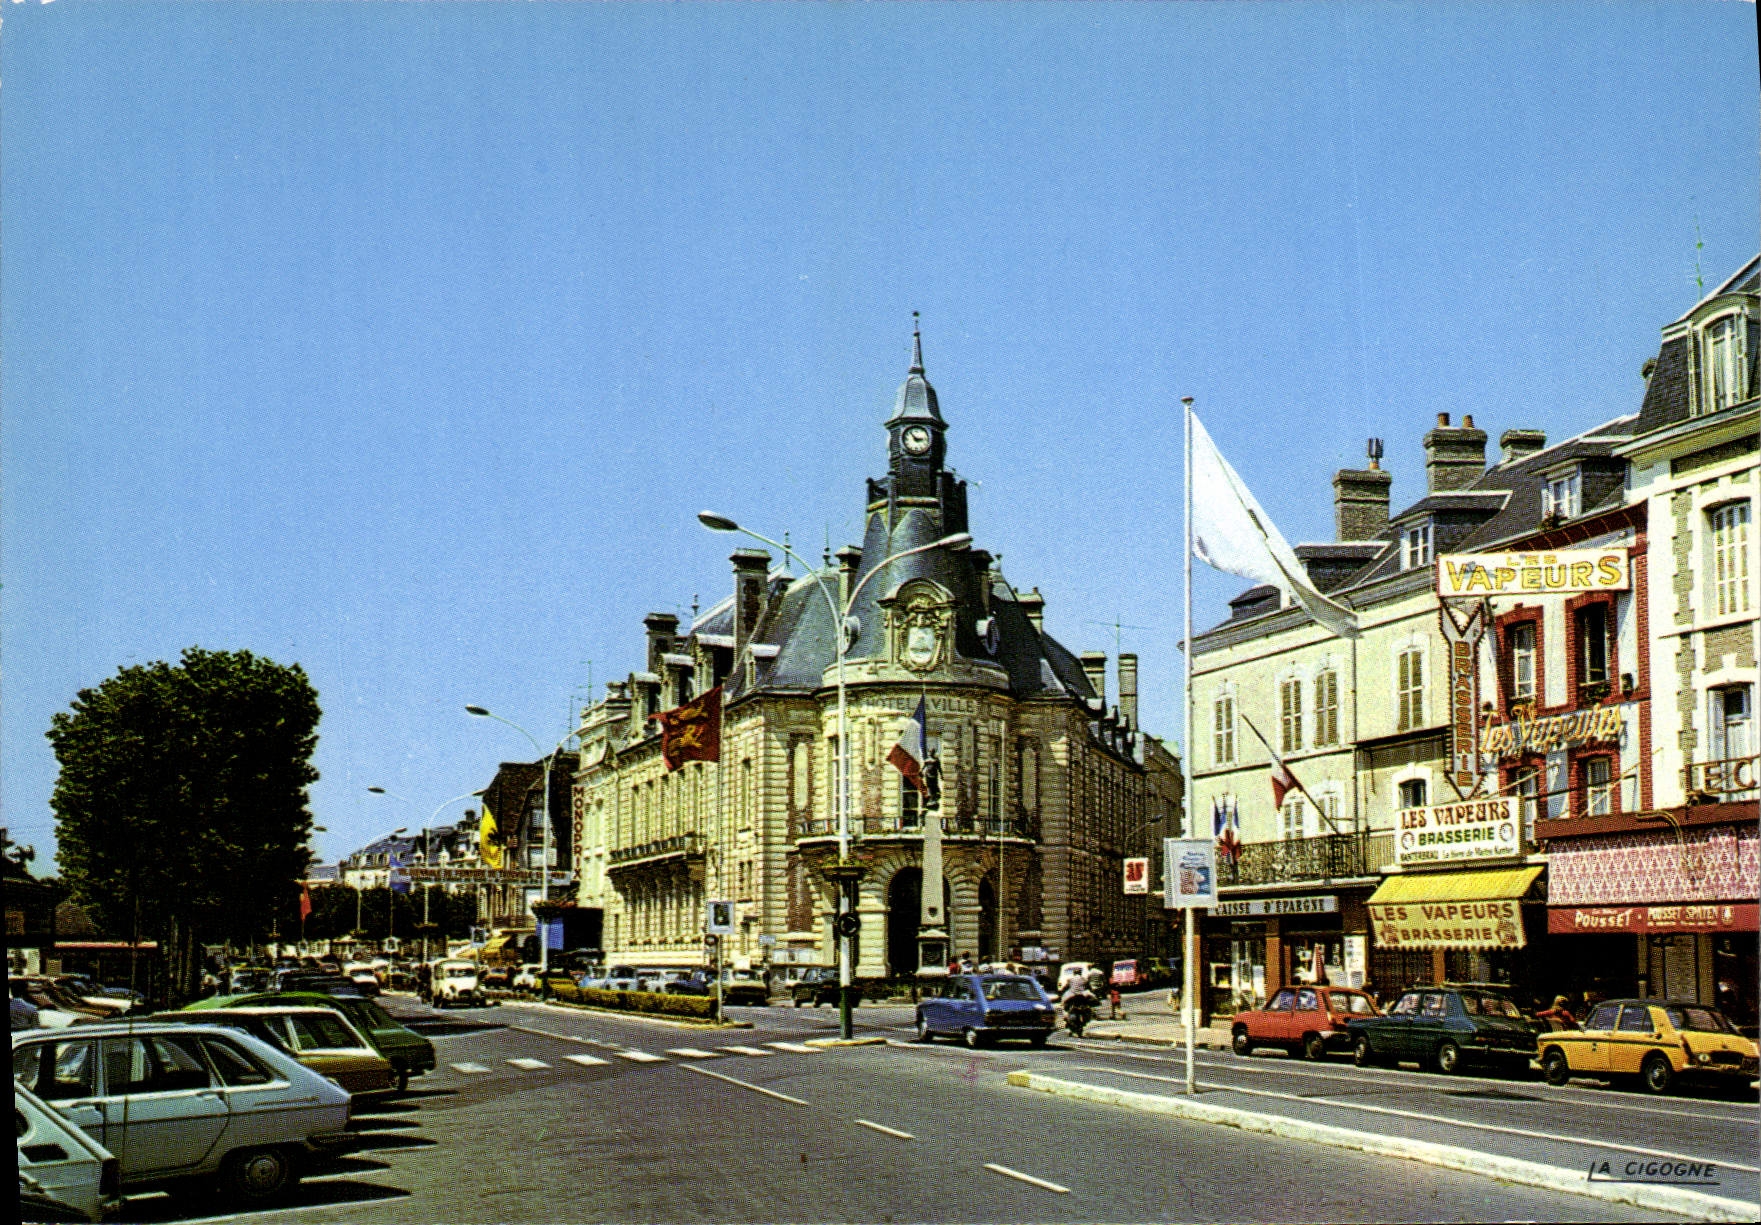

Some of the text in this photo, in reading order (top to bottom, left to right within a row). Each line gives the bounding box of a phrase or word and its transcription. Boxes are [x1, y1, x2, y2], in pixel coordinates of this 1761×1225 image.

[1506, 555, 1557, 566] LES
[1446, 555, 1622, 591] VAPEURS
[931, 697, 975, 713] VILLE
[1454, 641, 1473, 787] BRASSERIE
[1480, 700, 1622, 754] Les Vapeurs
[1401, 800, 1510, 829] LES VAPEURS
[573, 786, 584, 880] MONOPRIX
[1418, 826, 1495, 845] BRASSERIE
[1372, 903, 1514, 921] LES VAPEURS
[1575, 908, 1632, 928] POUSSET
[1401, 928, 1492, 940] BRASSERIE
